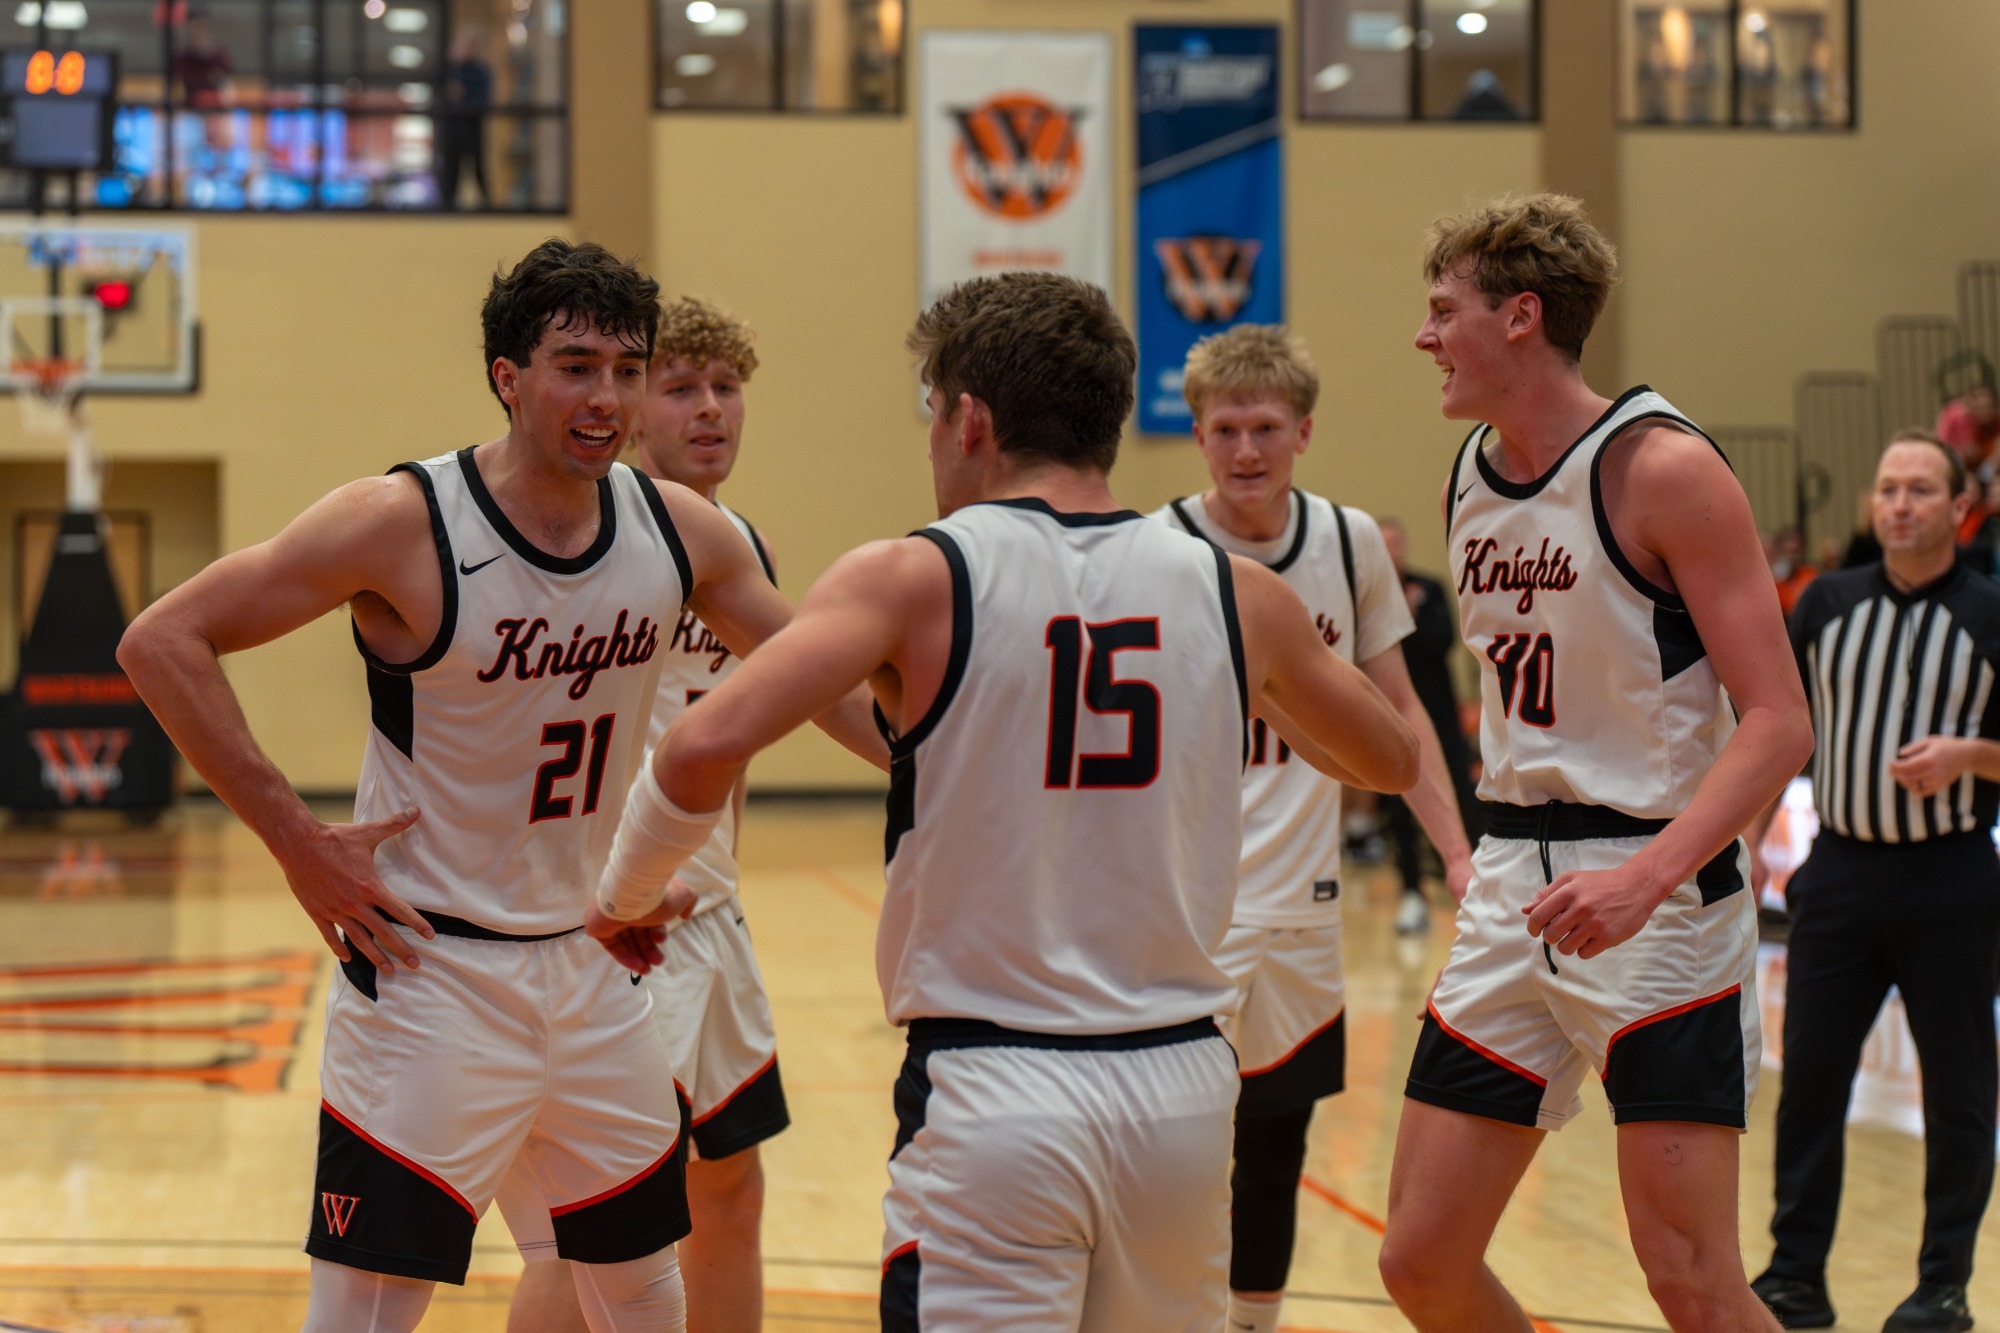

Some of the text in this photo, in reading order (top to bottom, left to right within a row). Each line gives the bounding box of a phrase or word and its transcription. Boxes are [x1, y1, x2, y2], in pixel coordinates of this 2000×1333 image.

[1458, 537, 1578, 615] Knights
[477, 609, 659, 701] Knights
[1044, 615, 1161, 789] 15
[1486, 632, 1556, 728] 40
[529, 713, 616, 824] 21
[321, 1192, 361, 1238] W
